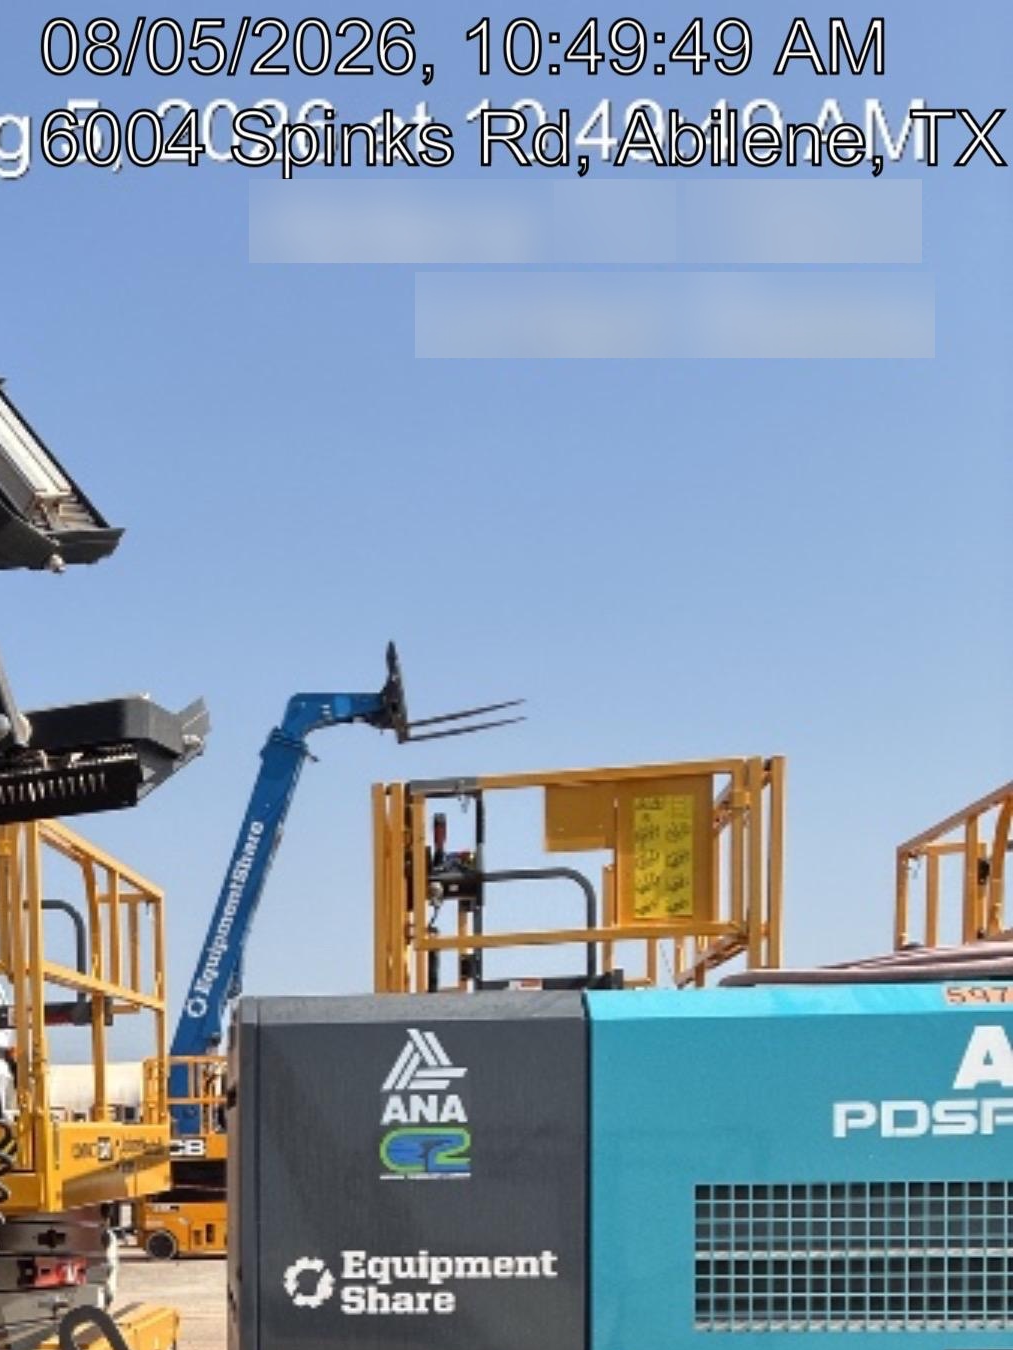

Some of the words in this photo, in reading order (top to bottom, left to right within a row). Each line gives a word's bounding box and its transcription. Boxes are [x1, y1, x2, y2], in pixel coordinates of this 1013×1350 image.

[193, 819, 266, 997] EquipmentShare
[379, 1094, 469, 1125] ANA
[340, 1250, 560, 1286] Equipment
[340, 1285, 457, 1315] Share
